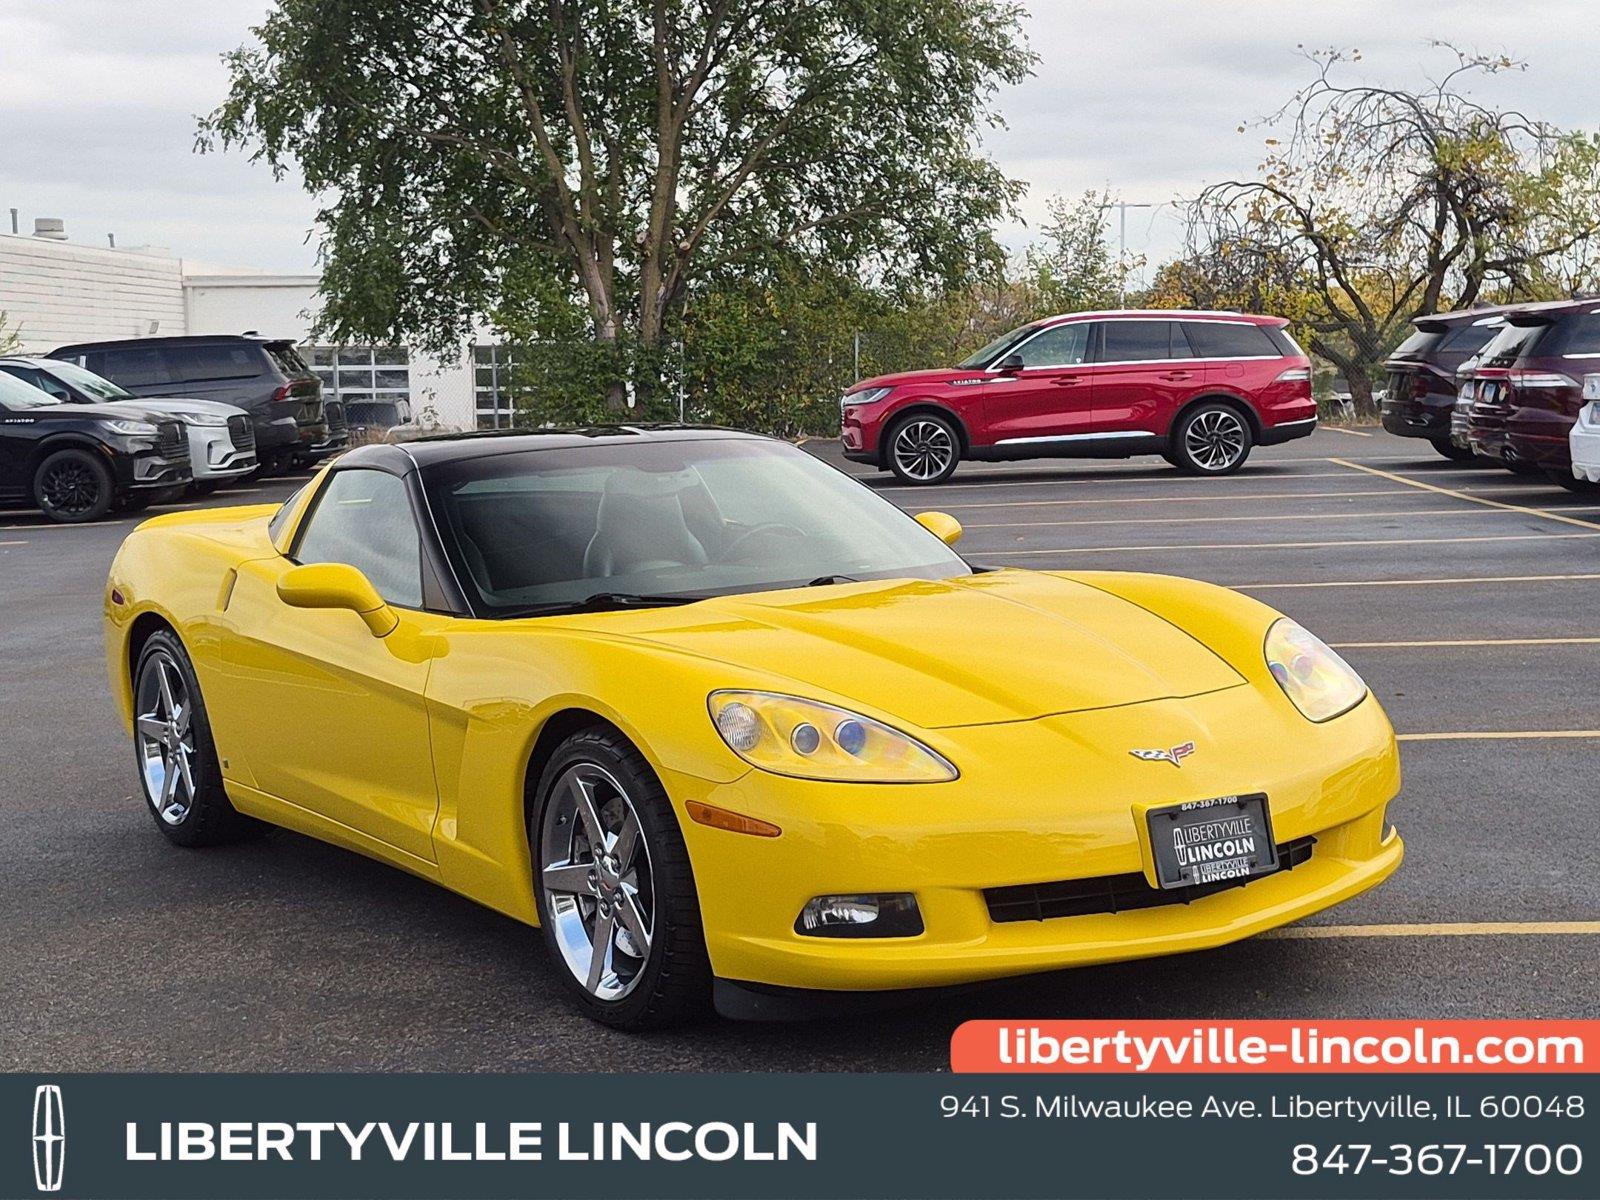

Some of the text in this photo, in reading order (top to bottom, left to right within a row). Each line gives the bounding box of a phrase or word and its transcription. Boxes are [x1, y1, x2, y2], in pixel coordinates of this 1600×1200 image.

[1181, 796, 1238, 811] 847-367-1700
[1184, 818, 1252, 844] LIBERTYVILLE
[1187, 837, 1256, 863] LINCOLN
[1202, 867, 1251, 883] LINCOLN
